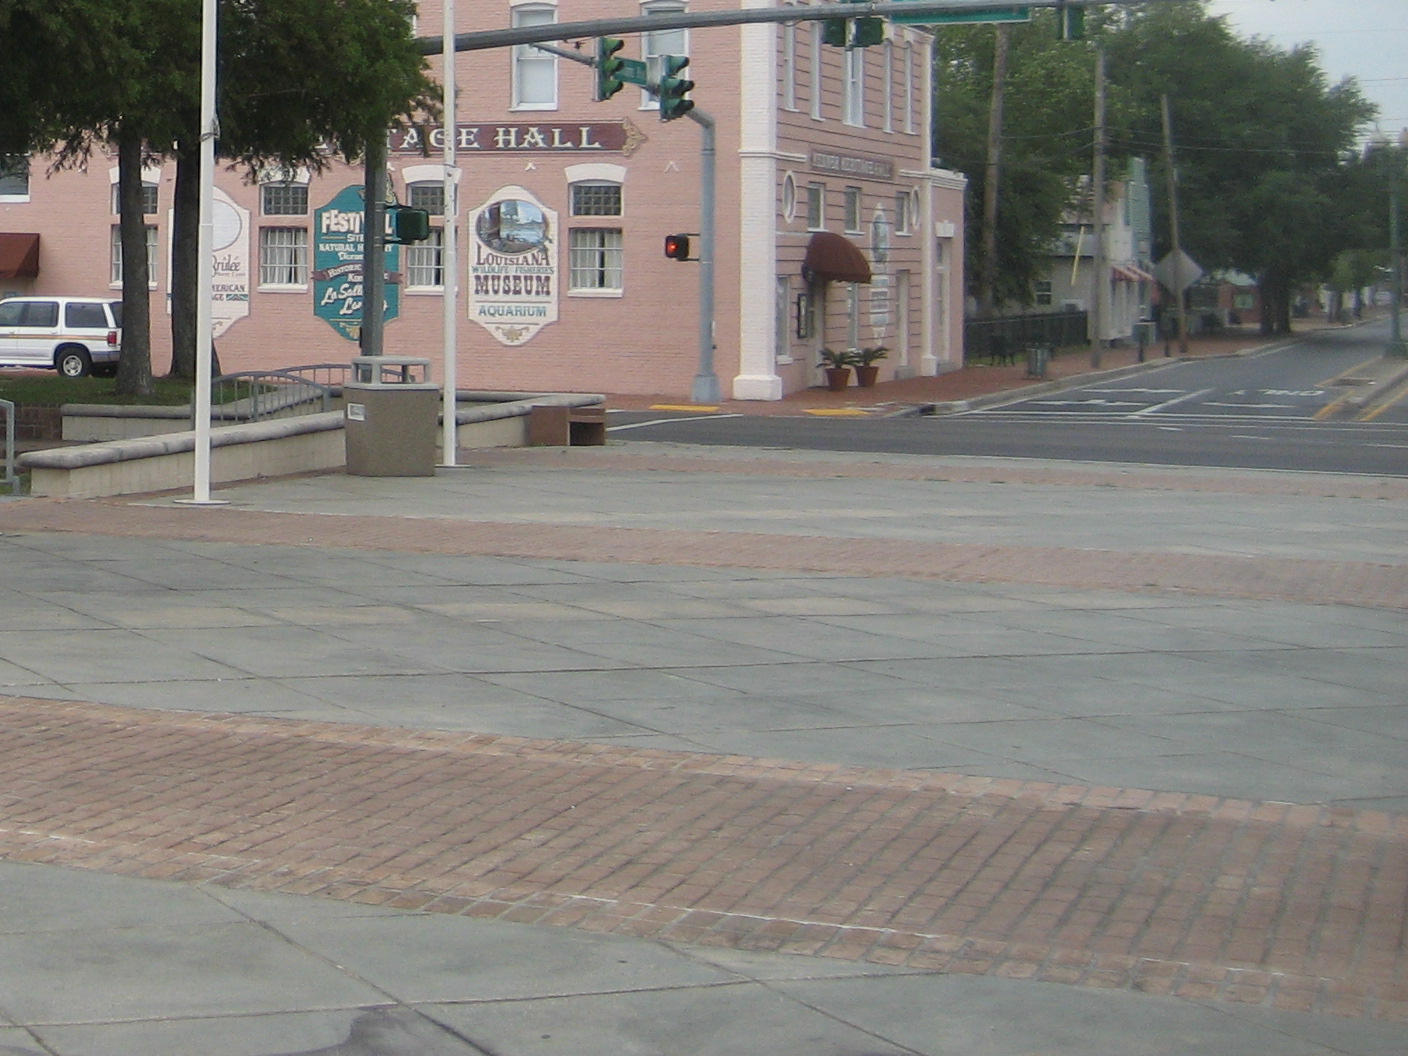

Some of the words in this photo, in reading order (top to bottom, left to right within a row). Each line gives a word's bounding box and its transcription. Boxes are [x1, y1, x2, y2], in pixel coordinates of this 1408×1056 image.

[493, 126, 602, 149] HALL
[321, 209, 393, 234] FESTIL
[319, 243, 355, 252] NATURAL
[476, 241, 551, 265] LOUISIANA
[474, 274, 551, 296] MUSEUM
[478, 305, 547, 318] AQUARIUM
